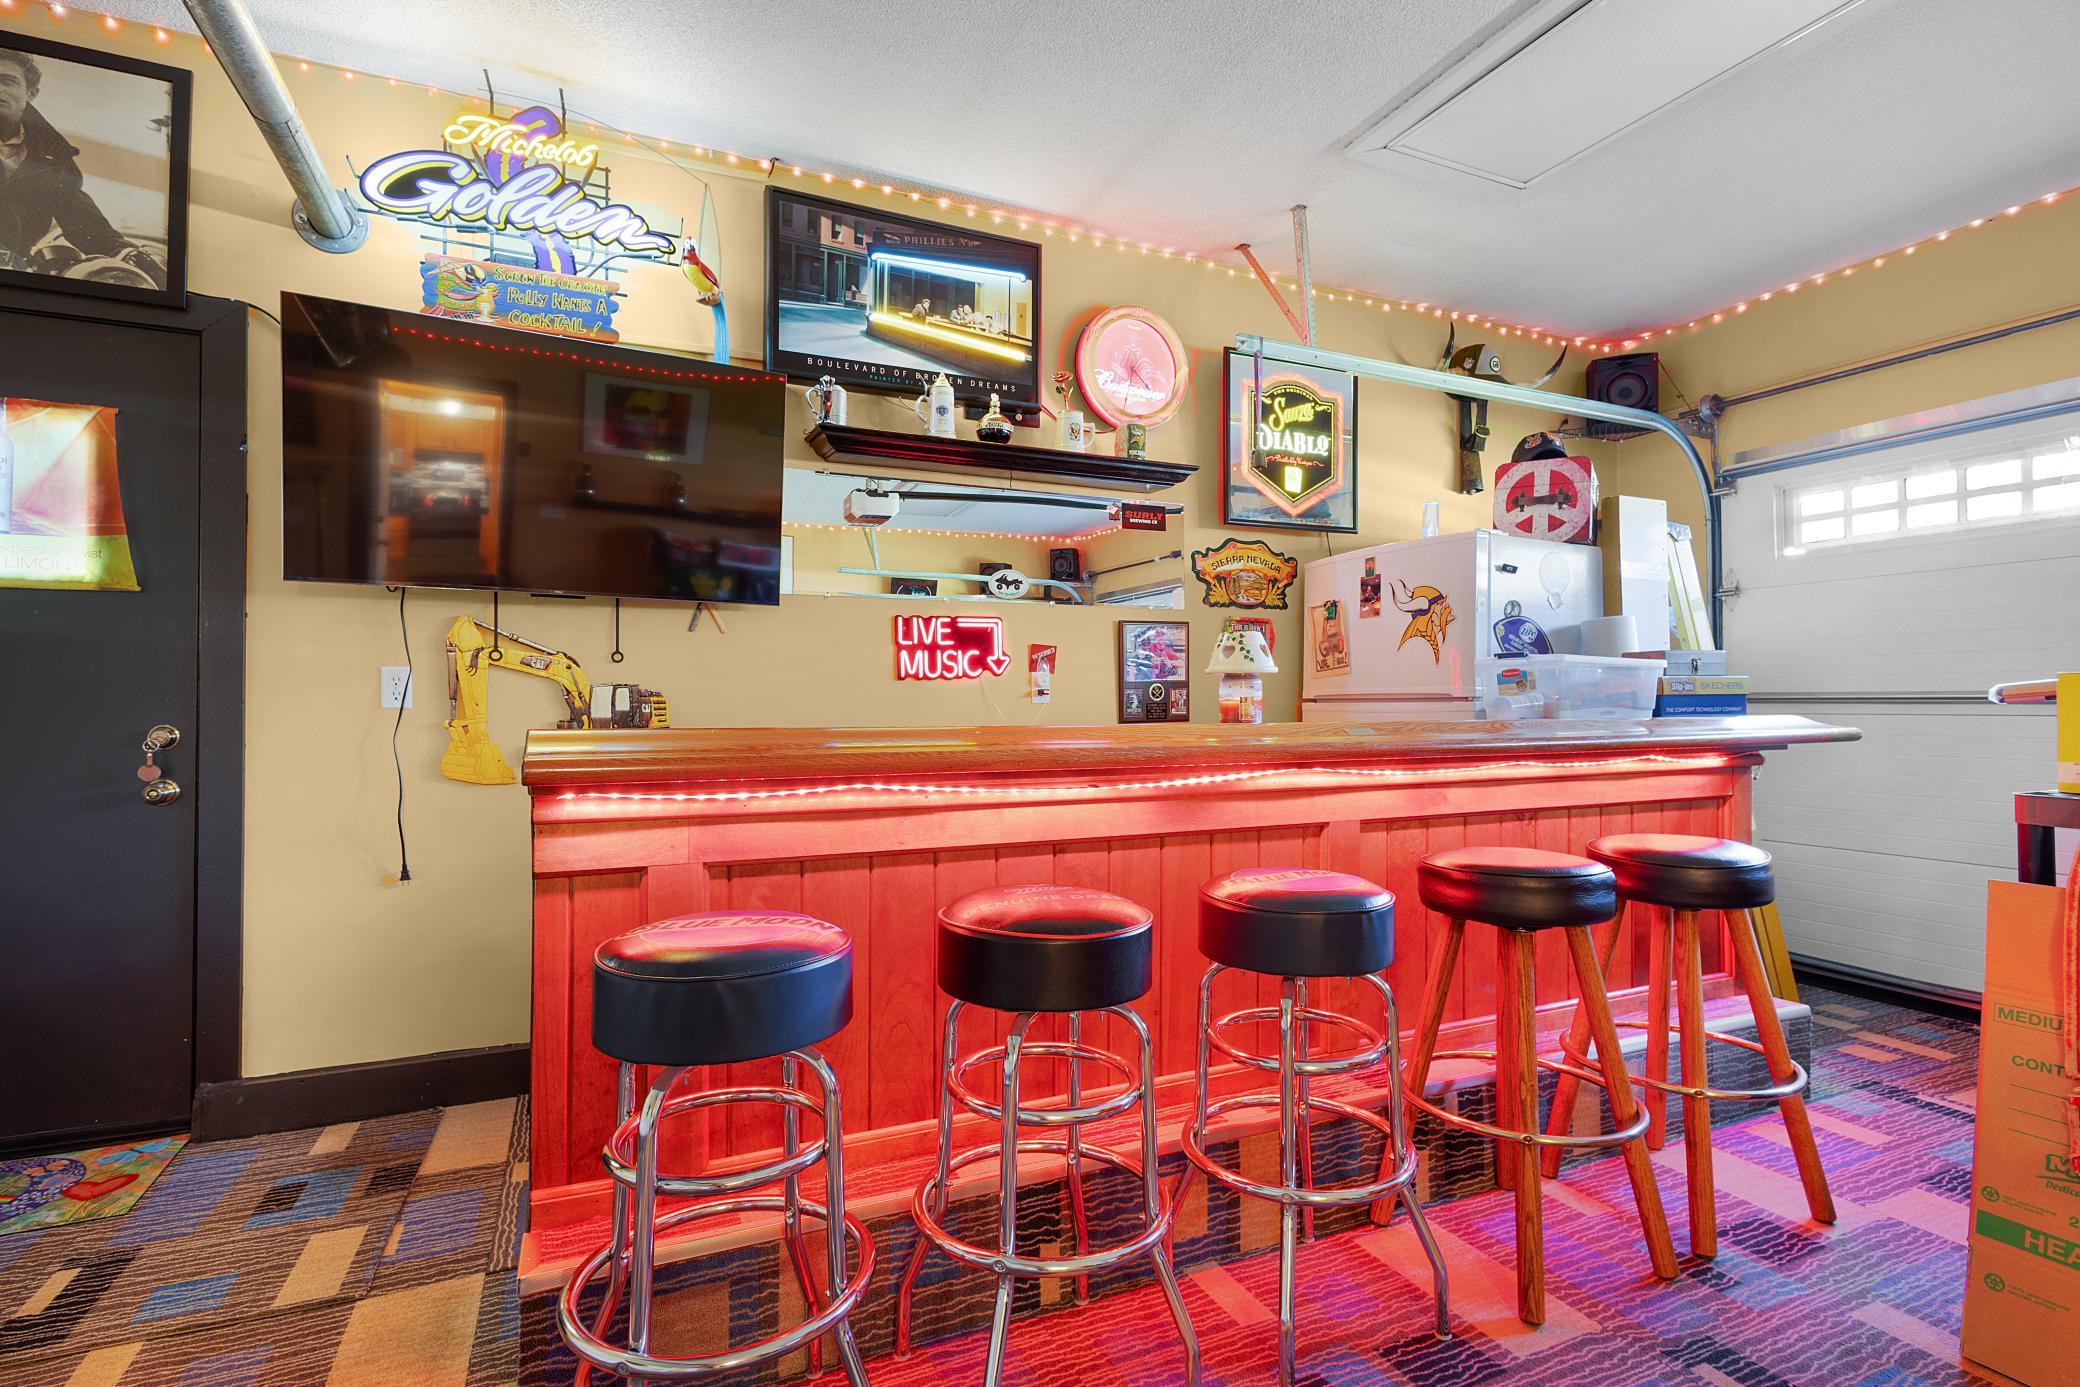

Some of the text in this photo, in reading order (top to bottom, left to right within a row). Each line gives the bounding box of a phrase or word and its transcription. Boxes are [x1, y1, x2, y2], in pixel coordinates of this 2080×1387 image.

[444, 115, 599, 167] Michelob
[360, 150, 676, 255] Golden
[904, 235, 954, 247] PHILLIES
[596, 299, 608, 315] A
[807, 357, 1017, 393] BOULEVARD OF BROEN DREAMS
[1125, 510, 1163, 521] SURLY
[1211, 555, 1281, 574] SIERRA NEVADA
[897, 617, 955, 645] LIVE
[1521, 628, 1537, 637] Lite
[900, 649, 983, 679] MUSIC
[1700, 681, 1744, 690] SKECHERS
[1998, 1007, 2063, 1031] MEDIU
[2012, 1055, 2065, 1076] CONT
[2046, 1181, 2080, 1198] Dedica
[2024, 1230, 2080, 1265] HEA
